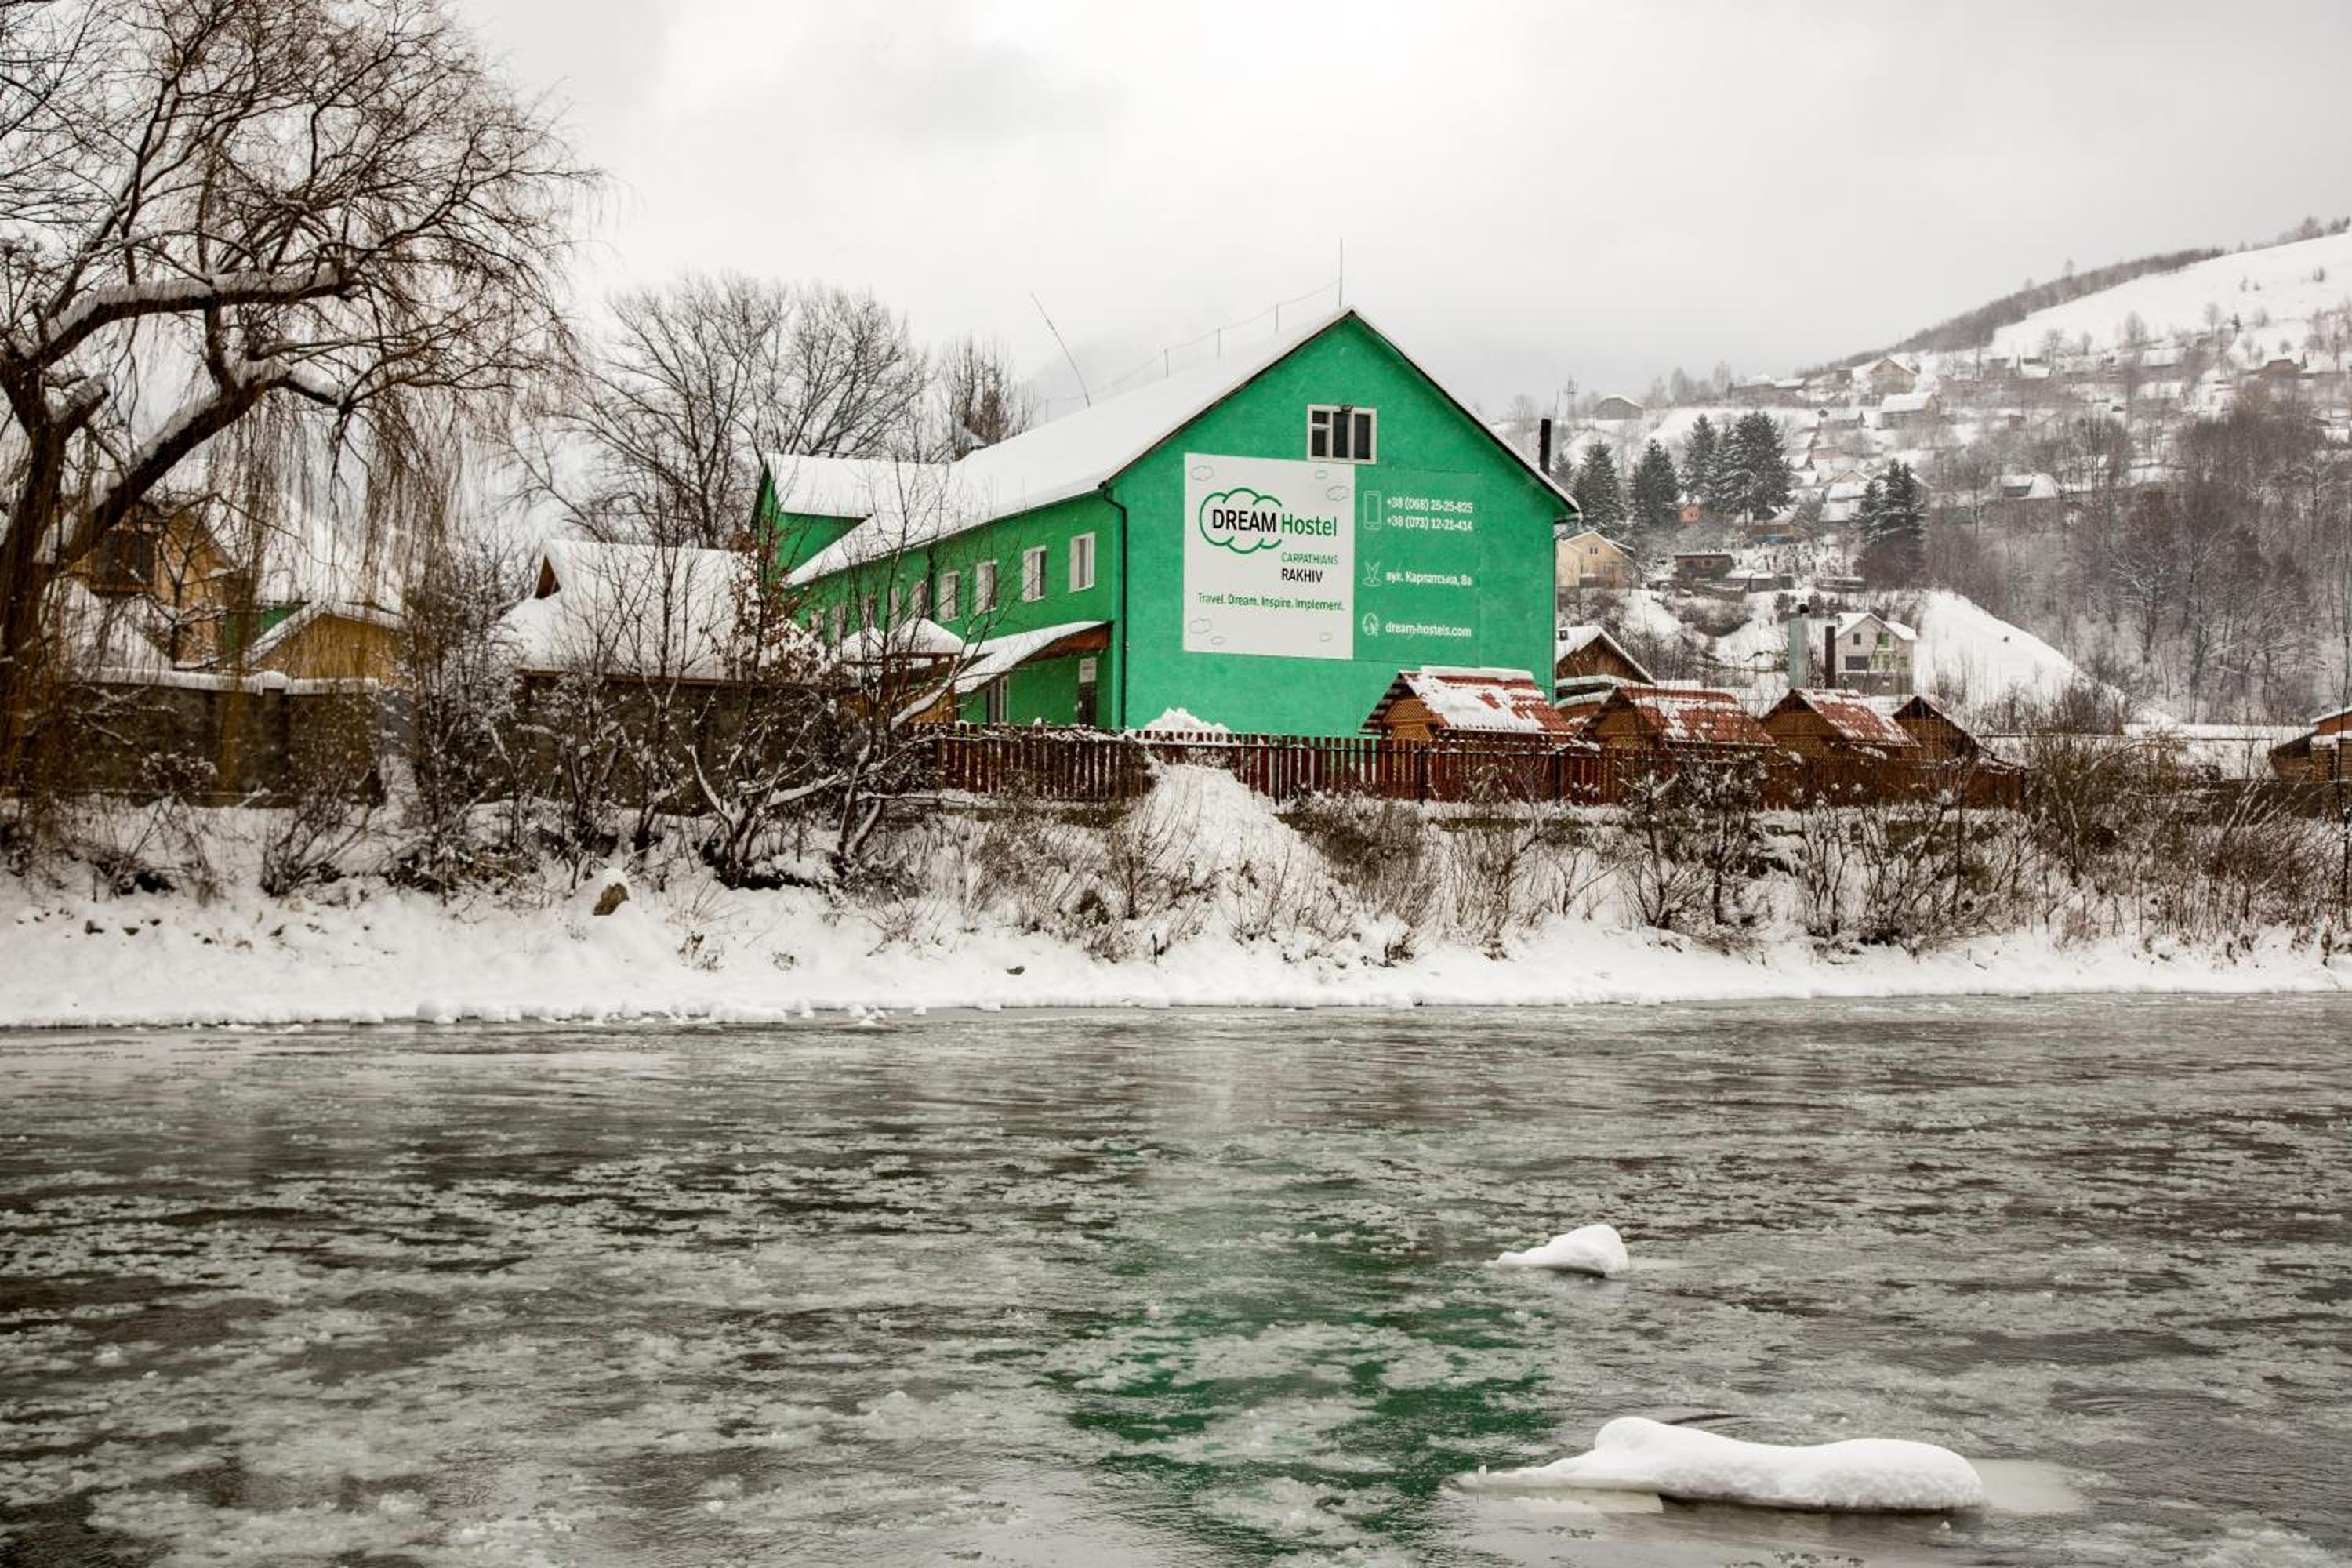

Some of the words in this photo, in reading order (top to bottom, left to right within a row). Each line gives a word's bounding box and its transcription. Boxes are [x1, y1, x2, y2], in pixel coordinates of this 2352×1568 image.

[1387, 497, 1403, 509] +38
[1212, 509, 1276, 532] DREAM
[1281, 514, 1337, 537] Hostel
[1387, 516, 1403, 527] +38
[1405, 516, 1429, 530] (073)
[1281, 551, 1338, 565] CARPATHIANS
[1281, 568, 1323, 583] RAKHIV
[1198, 592, 1226, 605] Travel.
[1229, 593, 1259, 607] Dream.
[1261, 596, 1294, 609] Inspire.
[1296, 598, 1345, 612] Implement.
[1385, 621, 1472, 637] dream-hostels.com
